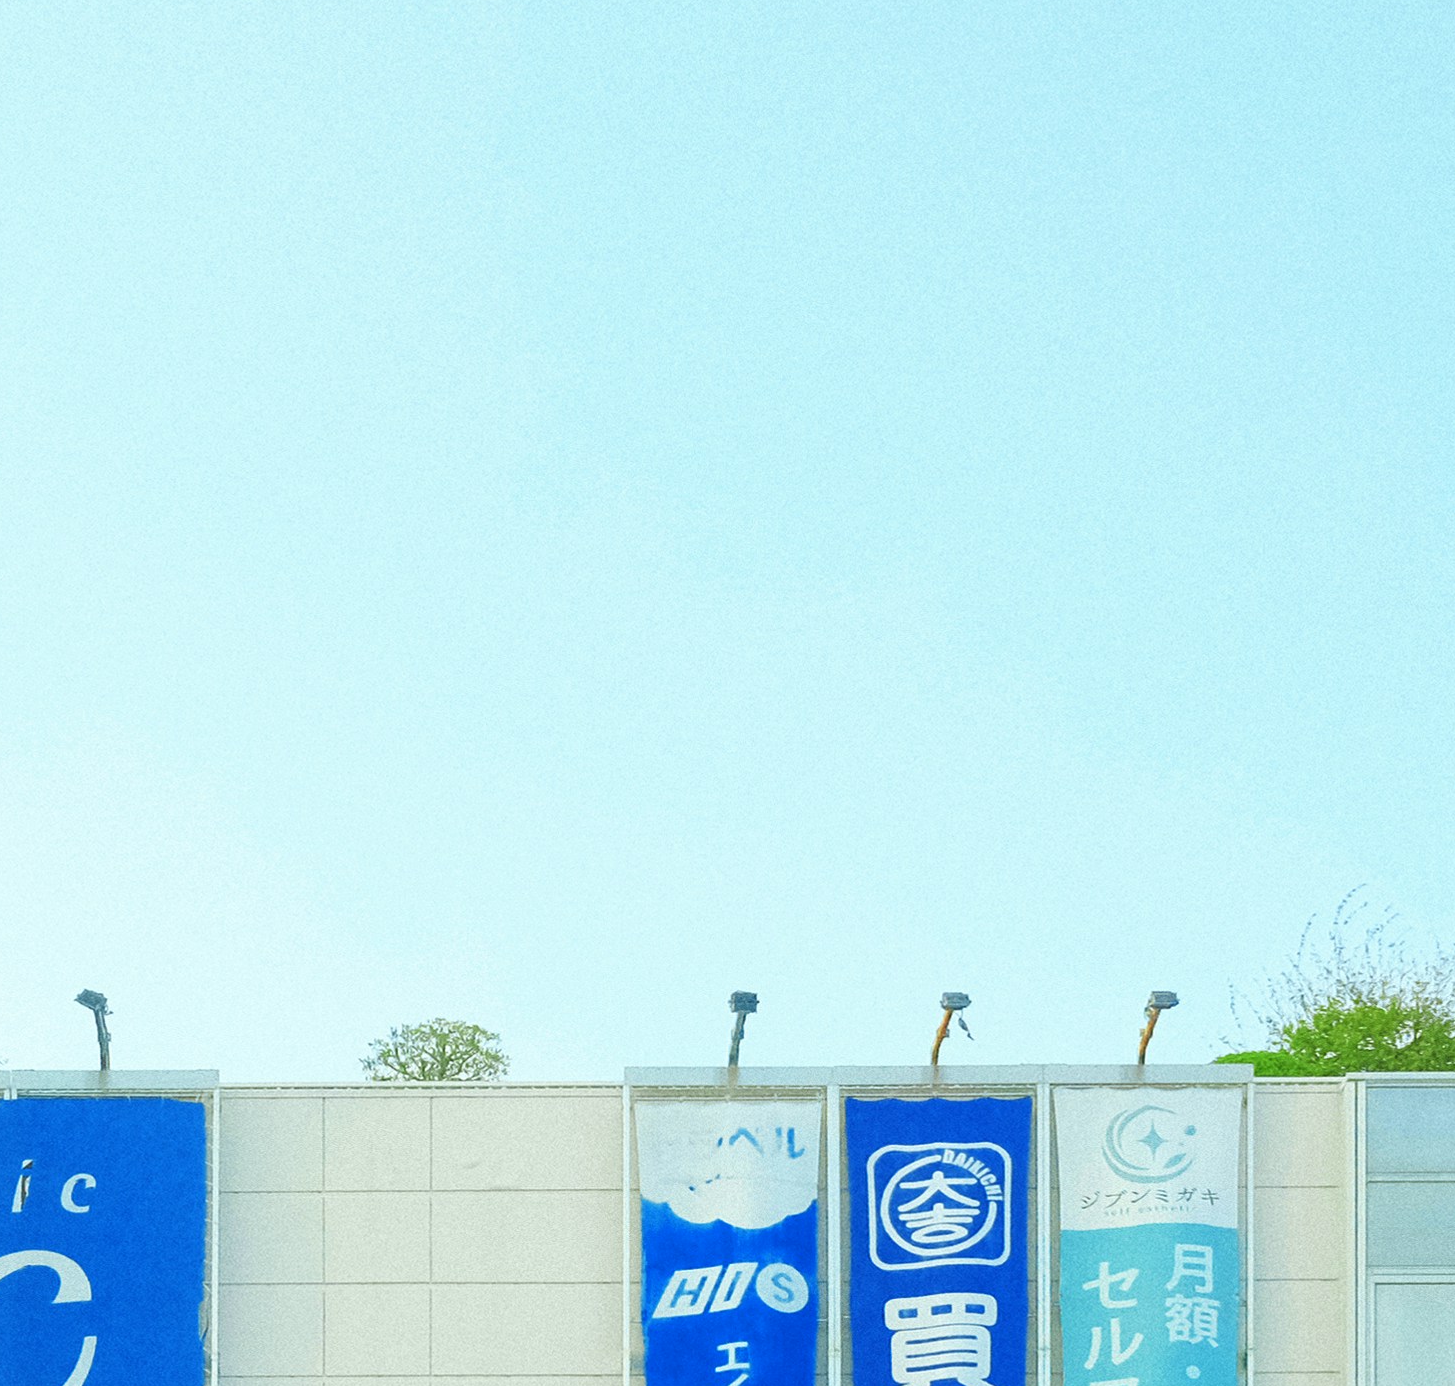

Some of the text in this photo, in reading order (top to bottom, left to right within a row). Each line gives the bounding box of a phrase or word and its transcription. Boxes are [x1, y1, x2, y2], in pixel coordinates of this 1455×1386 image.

[941, 1149, 1004, 1201] DAIKICHI
[1081, 1187, 1221, 1210] ジブンミガキ
[652, 1261, 809, 1319] HIS
